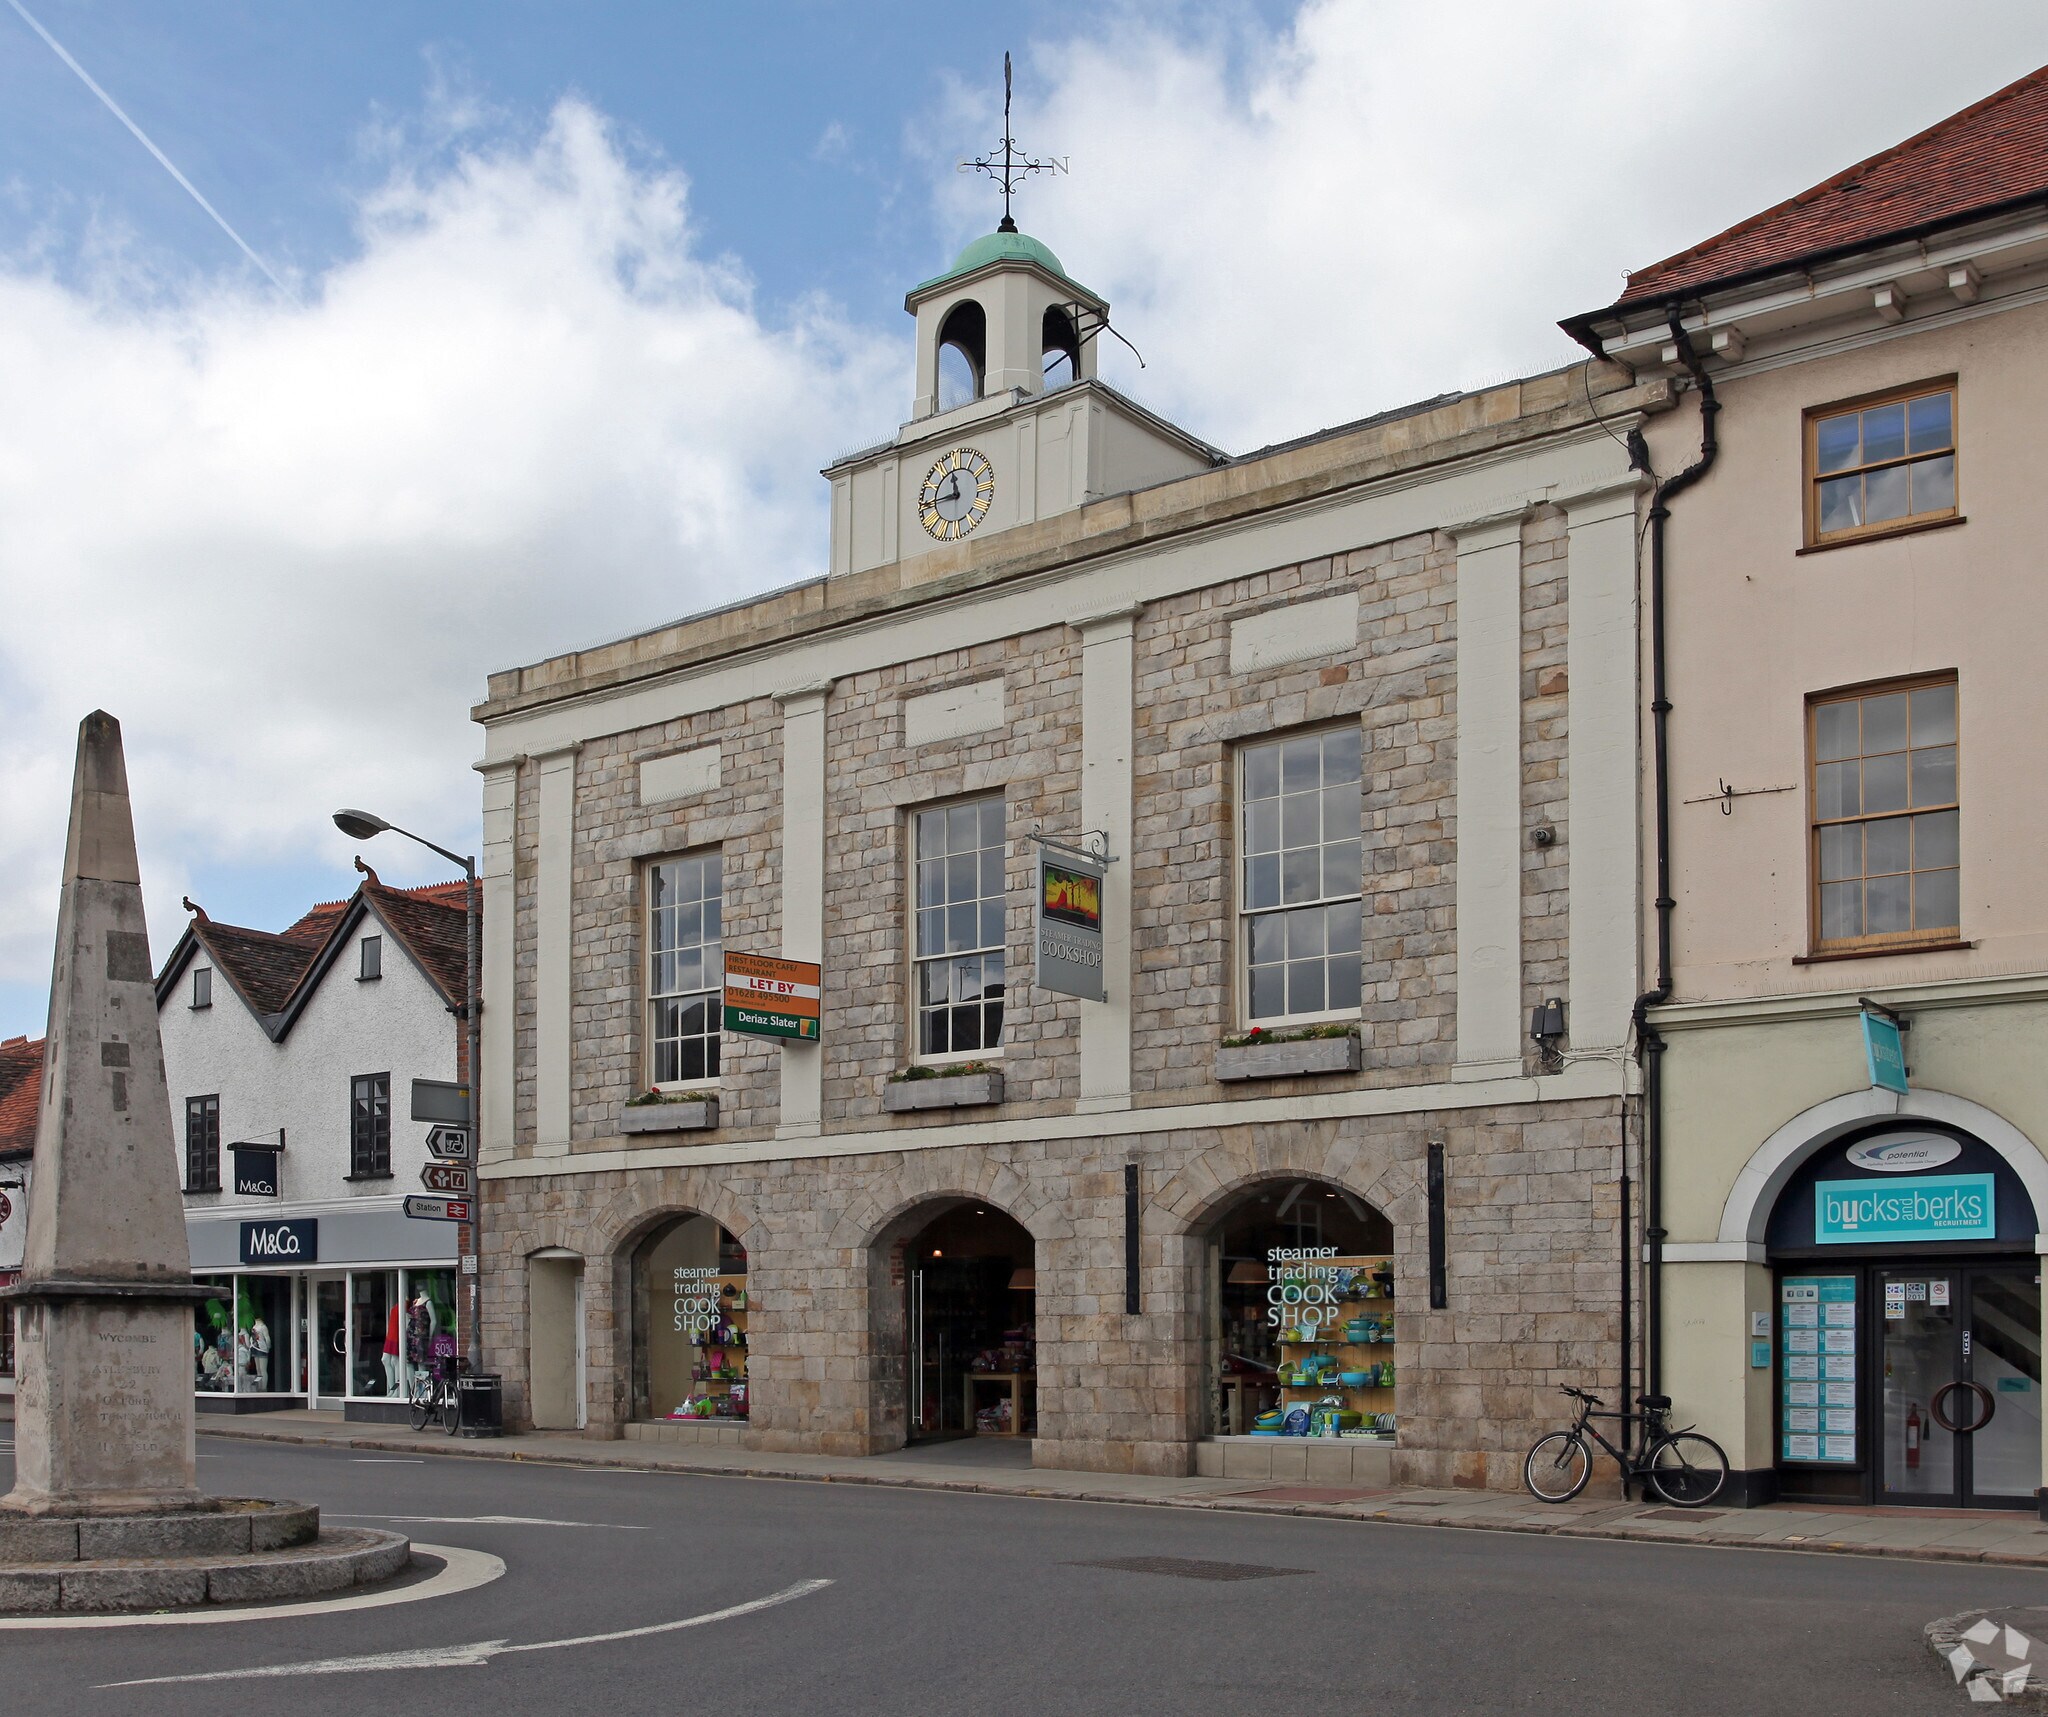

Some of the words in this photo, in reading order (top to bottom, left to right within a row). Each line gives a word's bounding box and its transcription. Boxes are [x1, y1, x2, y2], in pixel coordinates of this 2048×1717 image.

[1048, 156, 1070, 176] N
[1040, 928, 1072, 942] STEAMER
[1073, 936, 1101, 951] TRADING
[1040, 939, 1101, 968] COOKSHOP
[728, 965, 776, 978] RESTAURANT
[729, 956, 748, 965] FIRST
[749, 958, 774, 969] FLOOR
[775, 962, 798, 972] CAFE/
[749, 978, 774, 990] LET
[777, 982, 795, 993] BY
[728, 987, 755, 998] 01628
[757, 992, 790, 1003] 495500
[738, 1011, 768, 1025] Deriaz
[770, 1016, 798, 1028] Slater
[1886, 1150, 1929, 1160] potential
[240, 1179, 274, 1194] M&Co.
[416, 1202, 441, 1212] Station
[1827, 1192, 1900, 1224] bucks
[1900, 1198, 1914, 1221] and
[1914, 1189, 1982, 1221] berks
[1933, 1219, 1982, 1227] RECRUITMENT
[250, 1225, 301, 1255] M&Co.
[1267, 1246, 1339, 1262] steamer
[674, 1267, 721, 1279] steamer
[1267, 1262, 1339, 1284] trading
[674, 1279, 721, 1298] trading
[1267, 1284, 1340, 1305] COOK
[674, 1297, 721, 1315] COOK
[674, 1315, 721, 1331] SHOP
[1267, 1306, 1339, 1327] SHOP
[99, 1333, 157, 1343] WYCOMBE
[435, 1343, 453, 1355] 50%
